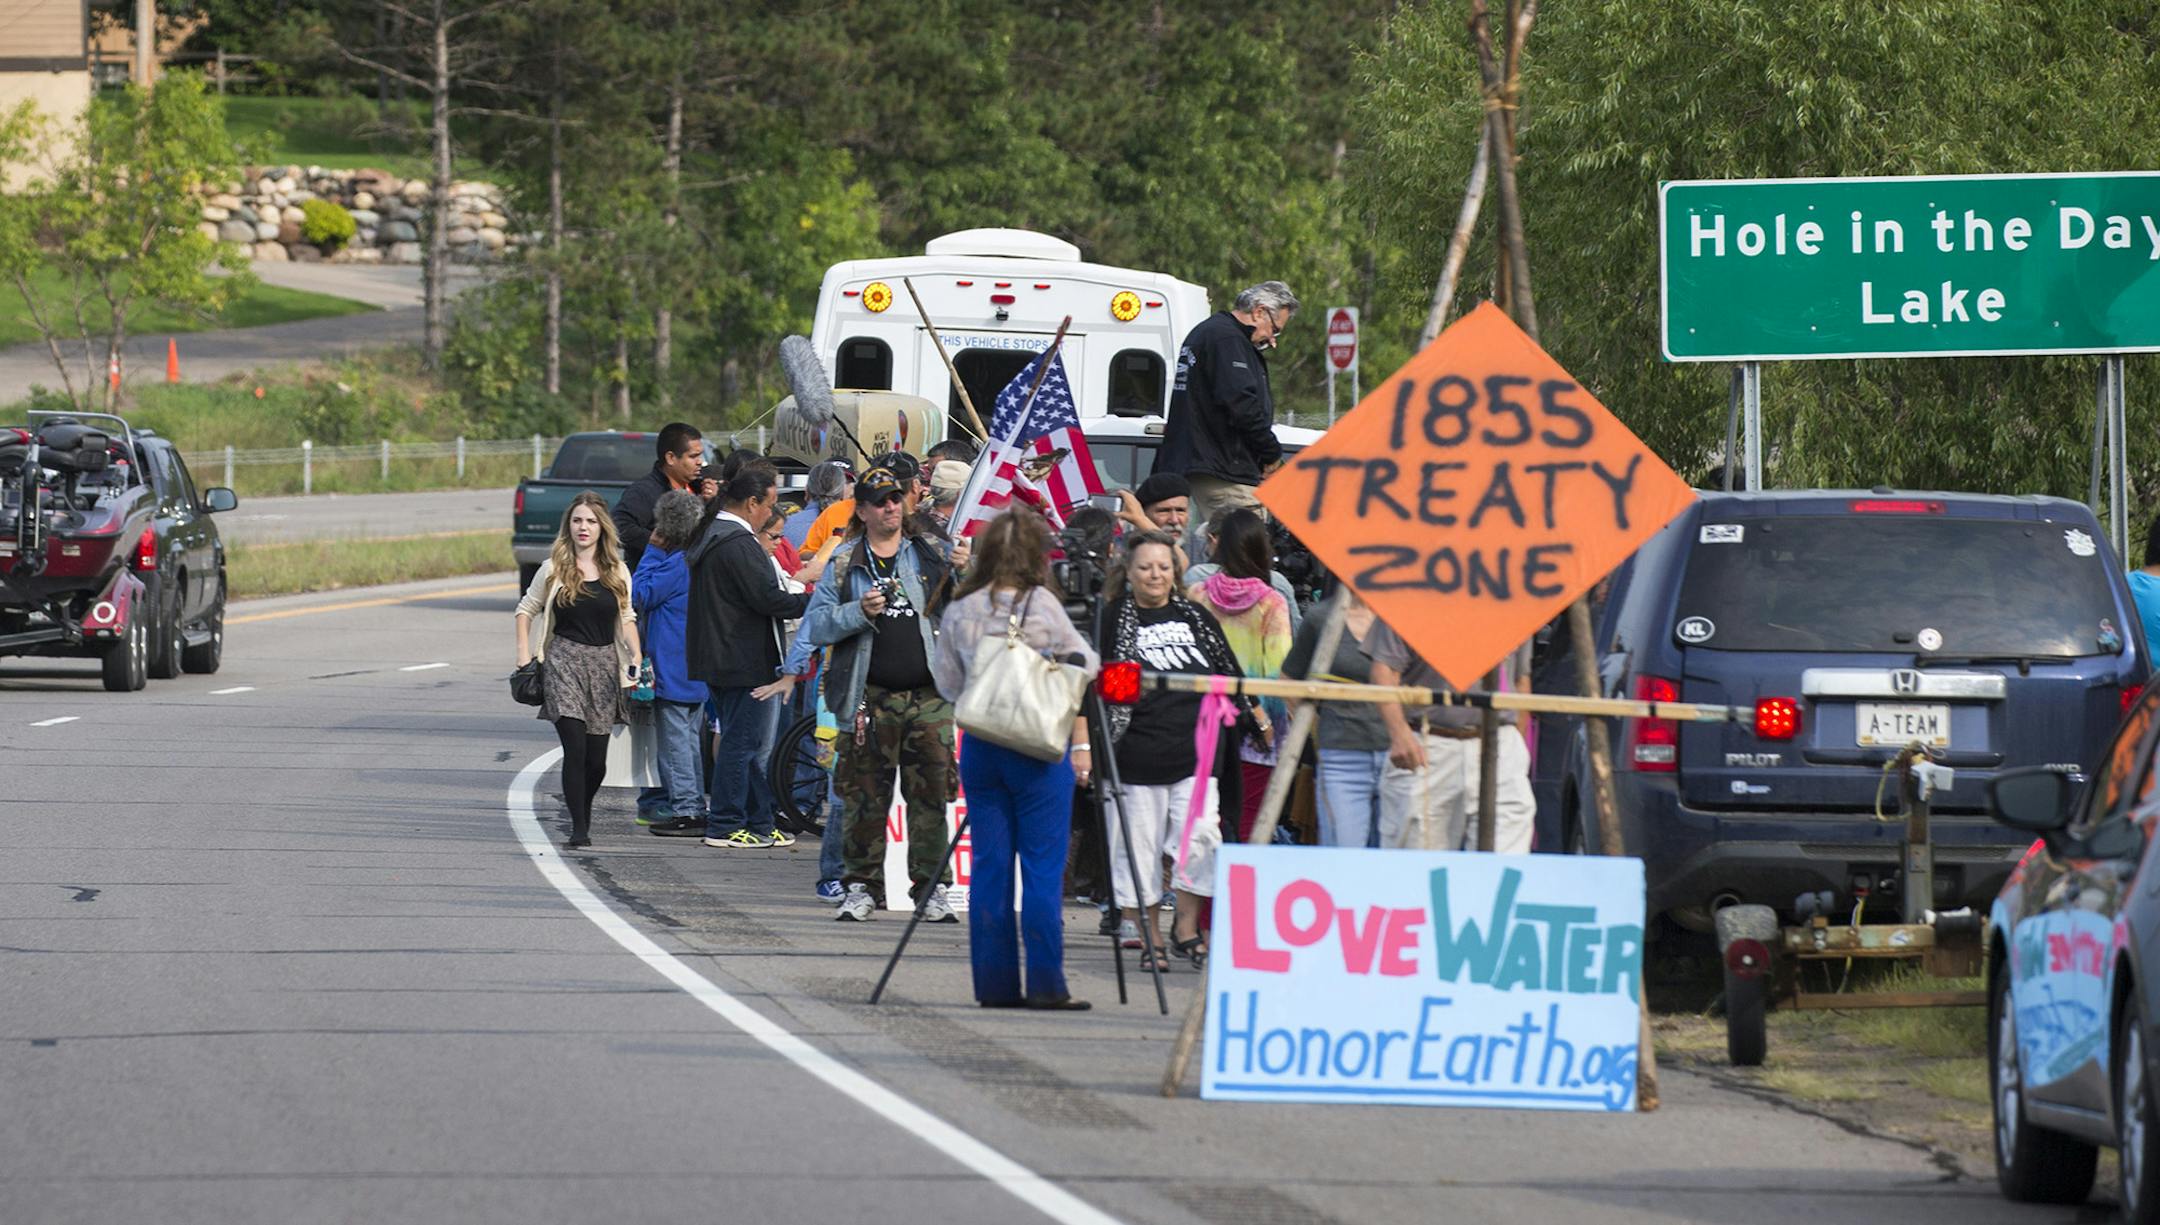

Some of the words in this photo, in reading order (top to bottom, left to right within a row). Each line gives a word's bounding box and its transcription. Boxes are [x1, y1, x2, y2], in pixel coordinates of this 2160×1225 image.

[1690, 213, 1824, 257] Hole
[1850, 210, 1905, 254] in
[1931, 209, 2033, 252] the
[1861, 281, 2006, 325] Lake
[939, 335, 961, 347] THIS
[964, 336, 1010, 348] VEHICLE
[1012, 338, 1049, 350] STOPS
[1389, 374, 1595, 450] 1855
[1297, 454, 1642, 531] TREATY
[1347, 543, 1574, 601] ZONE
[1870, 713, 1938, 735] A-TEAM
[1725, 752, 1782, 767] PILOT
[1429, 866, 1643, 1004] WATER
[1216, 990, 1640, 1112] HonorEarth.org
